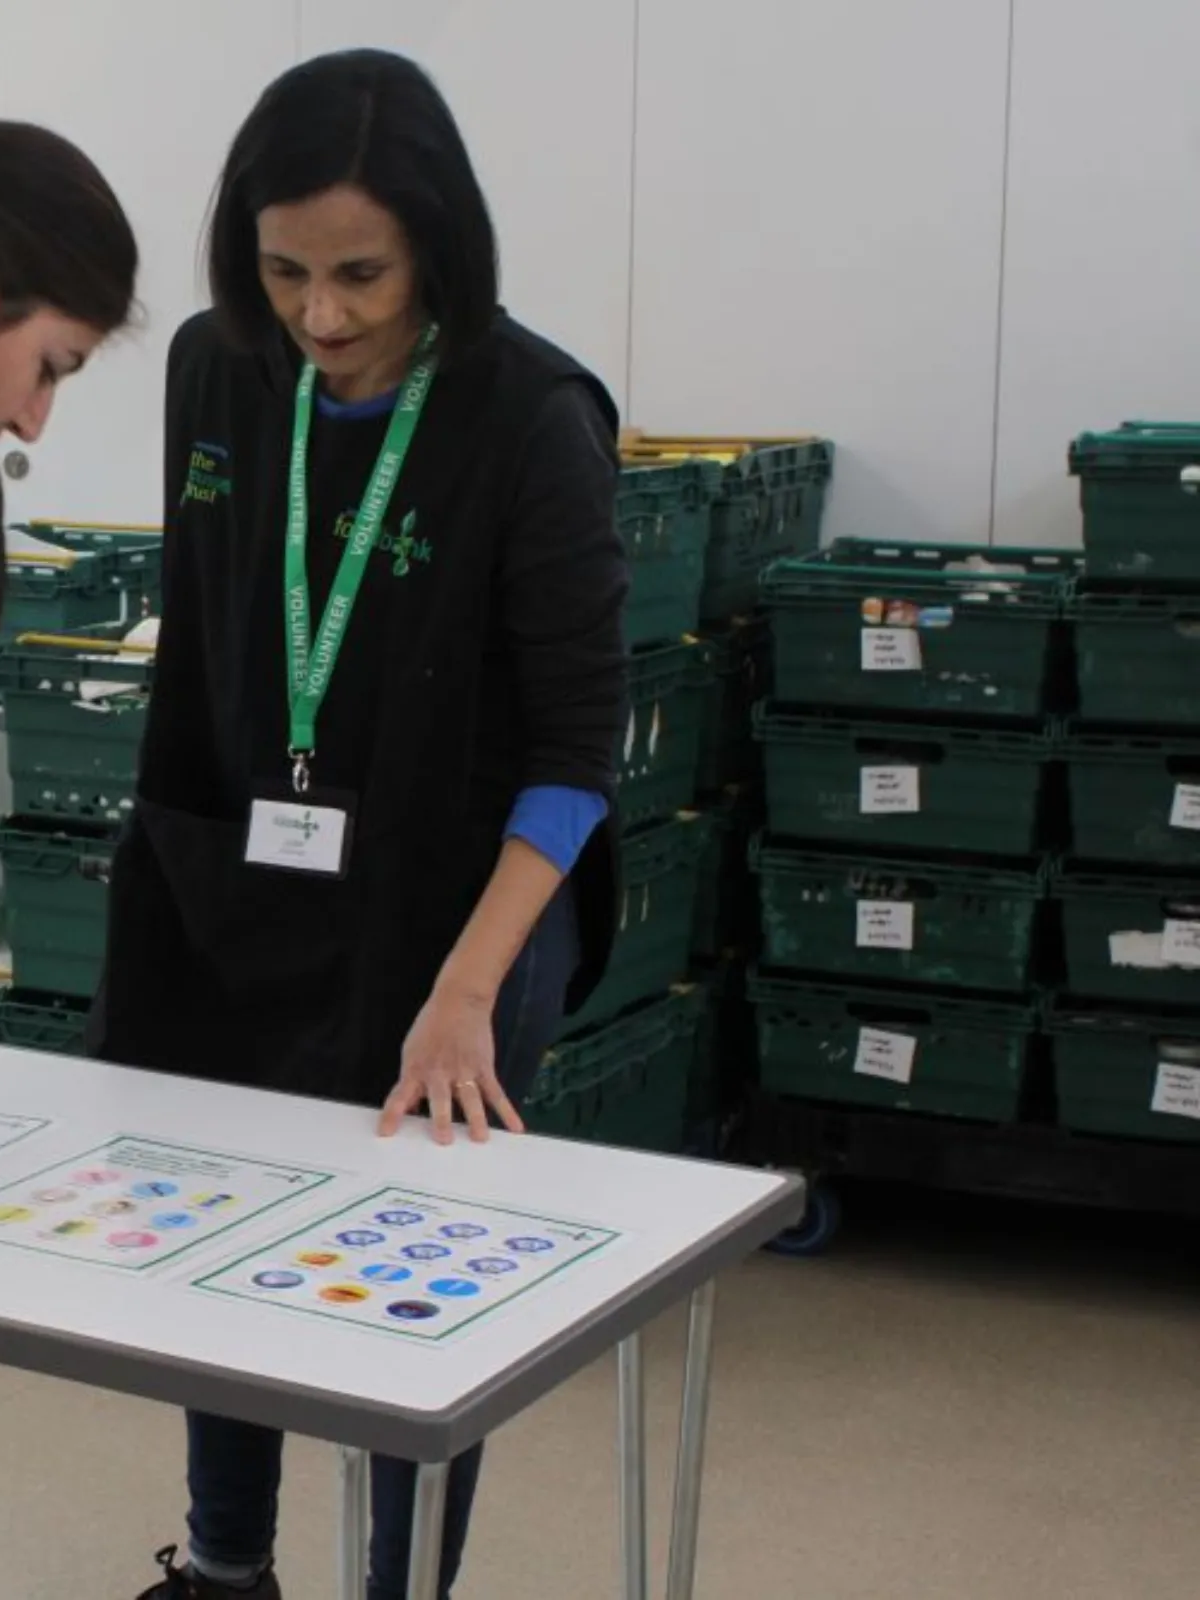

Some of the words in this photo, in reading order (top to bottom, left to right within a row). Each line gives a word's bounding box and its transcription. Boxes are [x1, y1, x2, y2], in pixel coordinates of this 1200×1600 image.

[190, 450, 217, 473] the
[350, 451, 400, 556] VOLUNTEER
[288, 584, 309, 692] VOLUNTEER
[304, 594, 351, 697] VOLUNTEER
